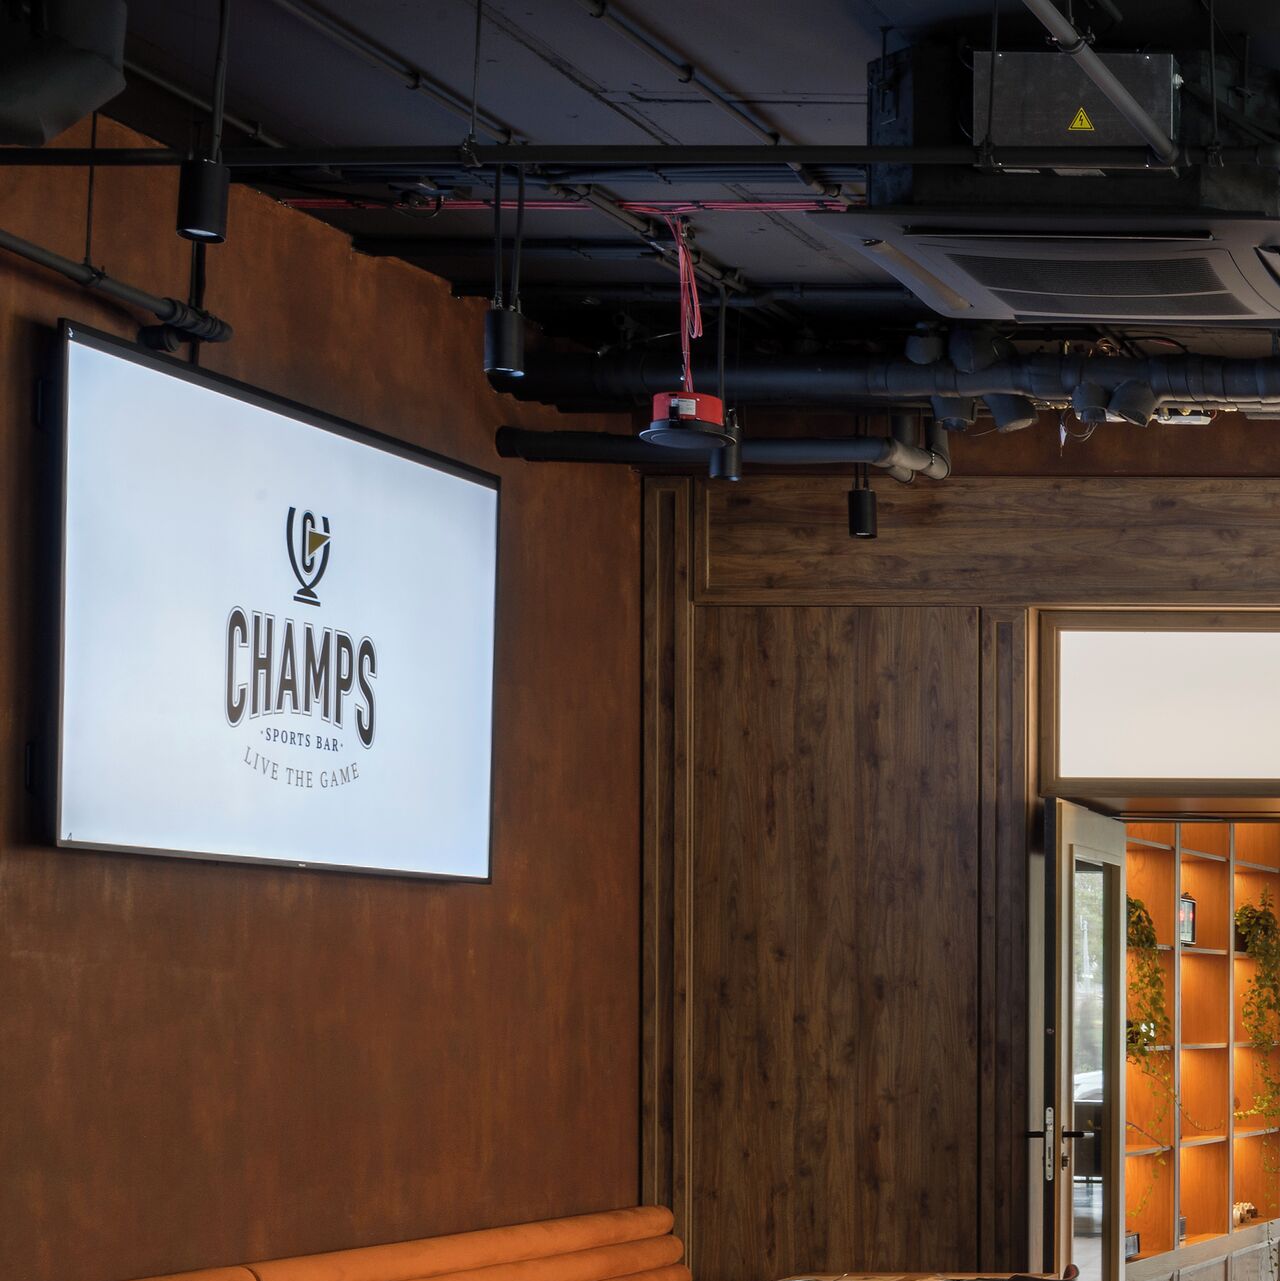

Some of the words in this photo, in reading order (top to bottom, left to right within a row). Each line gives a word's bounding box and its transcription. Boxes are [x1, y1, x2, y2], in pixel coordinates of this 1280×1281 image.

[225, 606, 377, 749] CHAMPS
[265, 727, 311, 749] SPORTS
[316, 735, 339, 752] BAR
[243, 746, 281, 782] LIVE
[286, 767, 314, 789] THE
[320, 762, 361, 789] GAME
